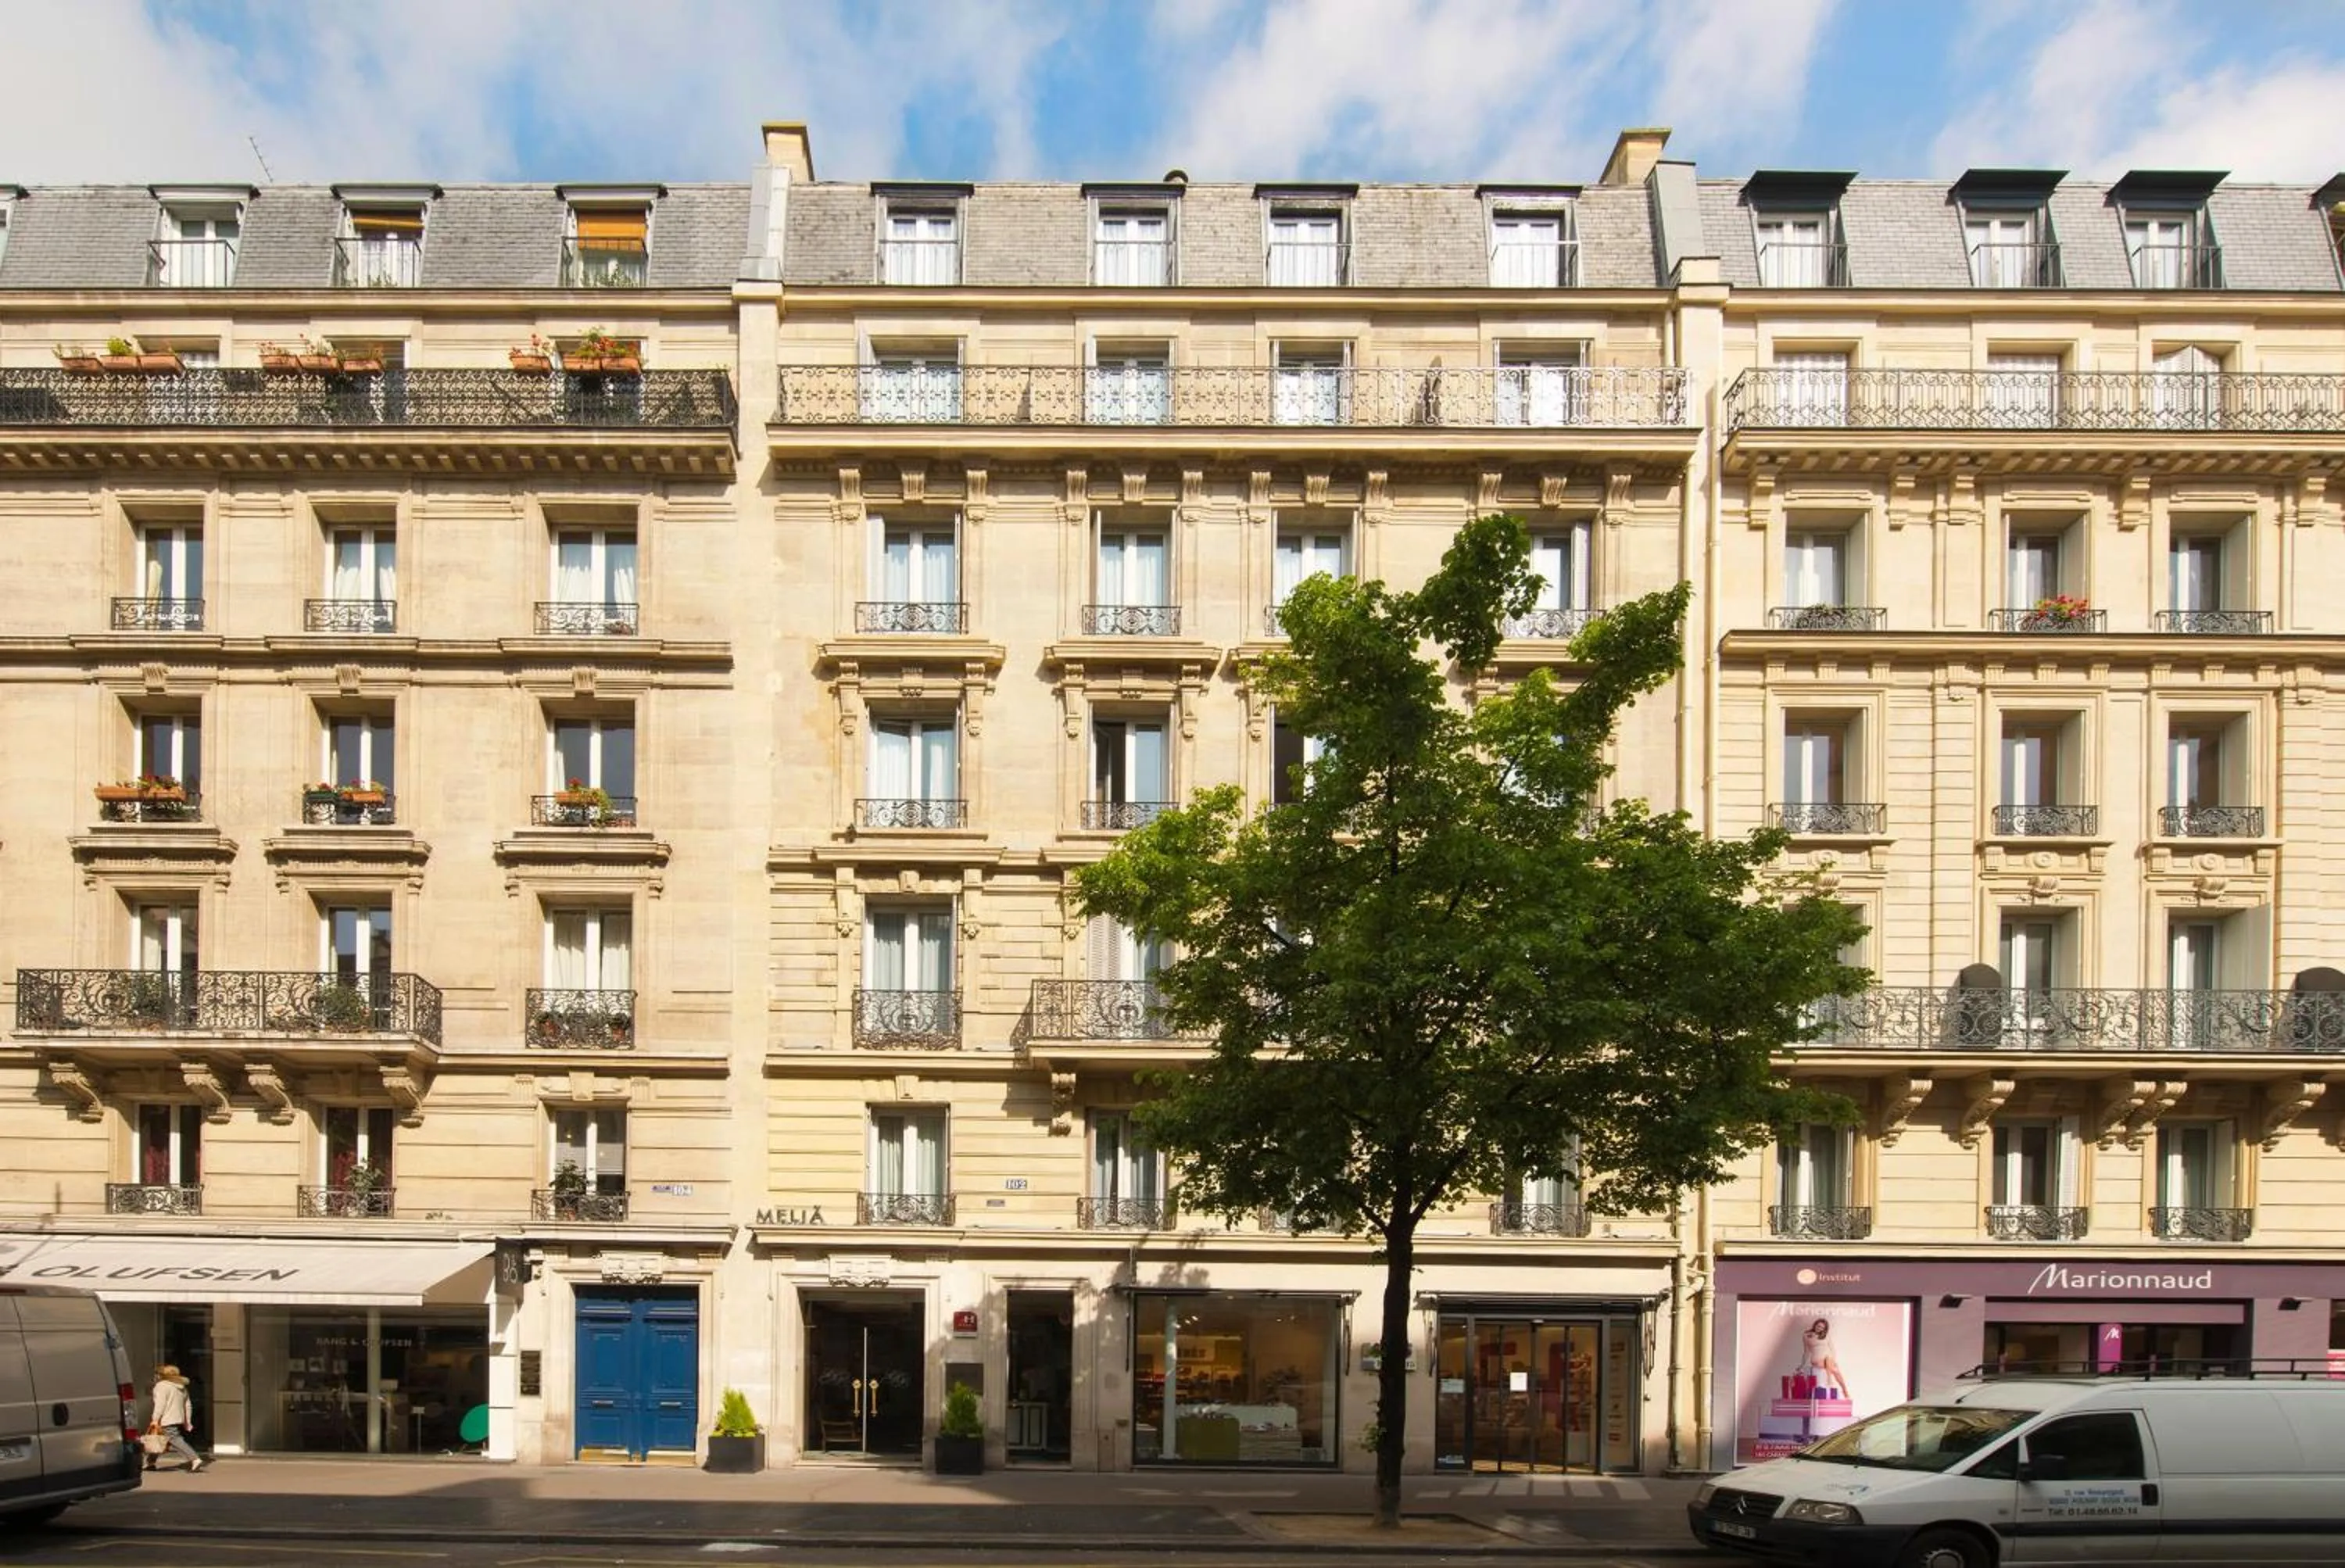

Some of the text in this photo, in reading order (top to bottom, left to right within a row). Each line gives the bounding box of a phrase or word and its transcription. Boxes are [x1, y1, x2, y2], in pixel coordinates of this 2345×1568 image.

[1006, 1179, 1027, 1189] 102
[32, 1265, 299, 1281] OLUFSEN
[1819, 1273, 1861, 1282] Institut
[2028, 1263, 2211, 1294] Marionnaud
[1768, 1301, 1876, 1323] Marionnaud
